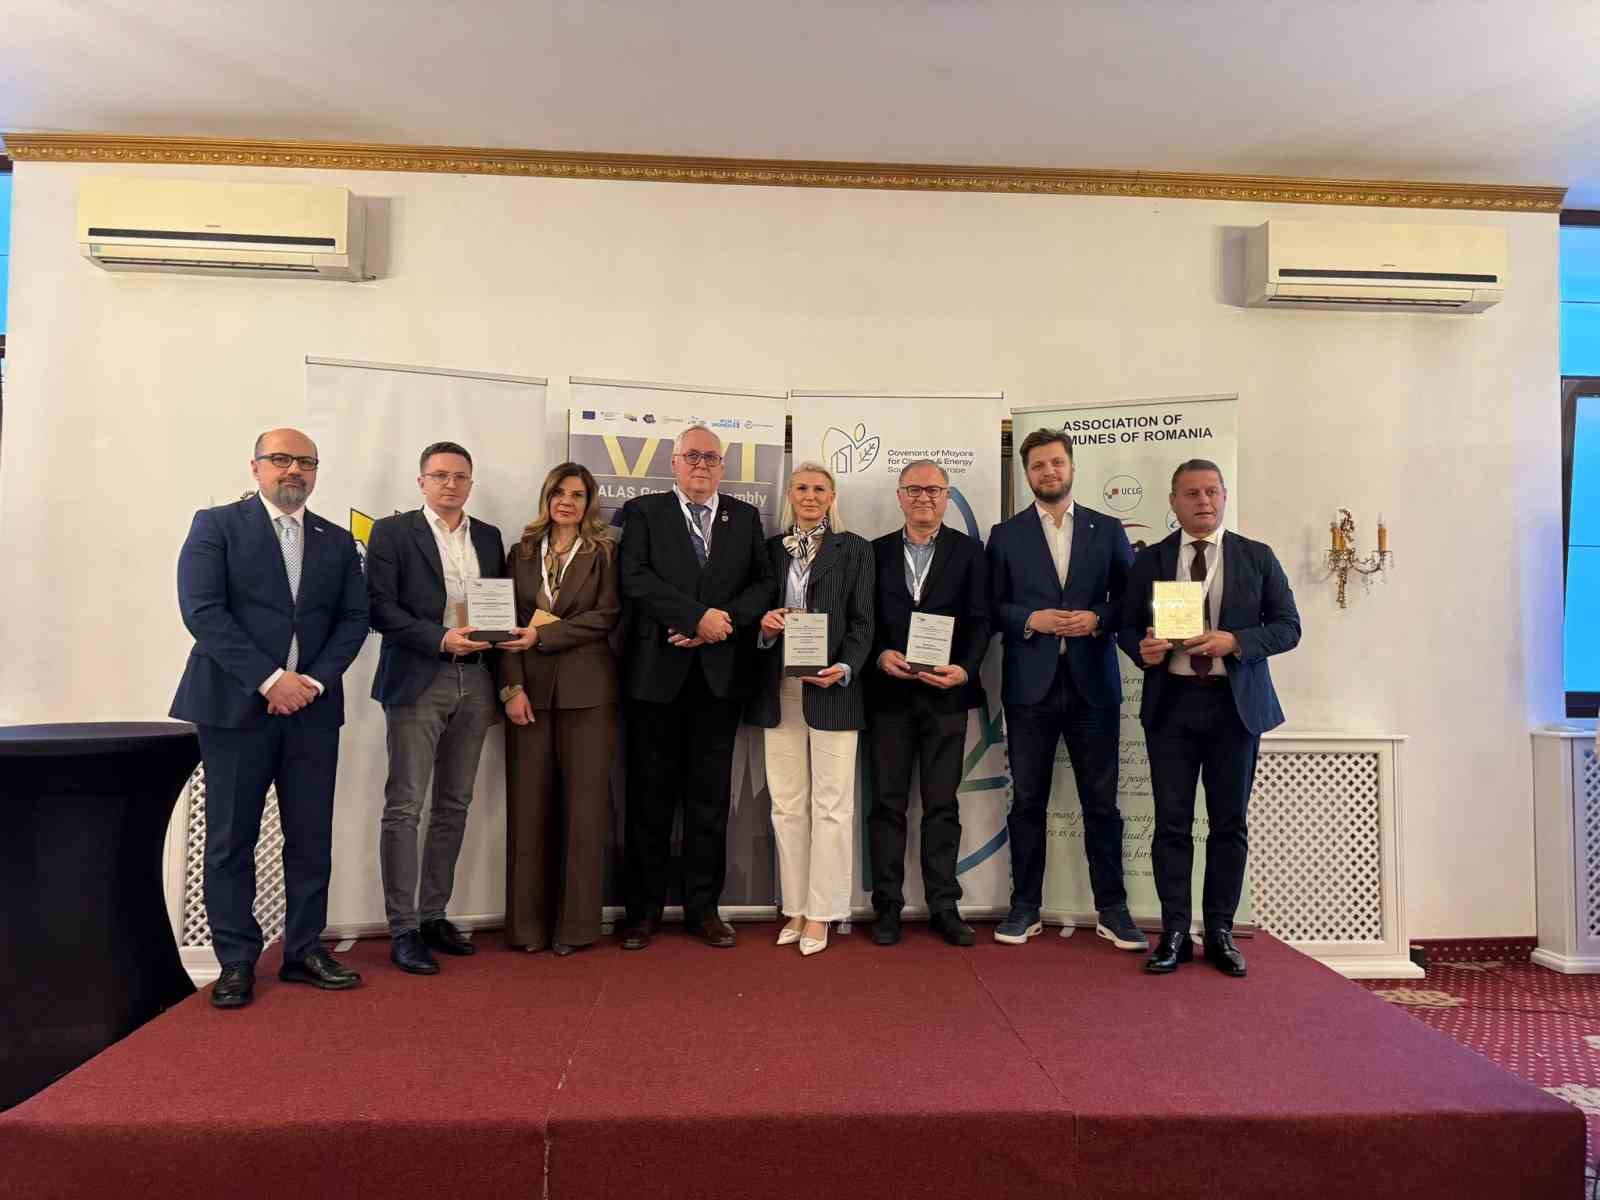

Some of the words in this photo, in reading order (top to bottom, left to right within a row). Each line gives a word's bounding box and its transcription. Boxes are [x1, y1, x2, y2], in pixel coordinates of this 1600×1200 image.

[1063, 415, 1159, 432] ASSOCIATION
[1163, 414, 1184, 426] OF
[1069, 433, 1117, 446] MUNES
[1120, 431, 1140, 443] OF
[1144, 427, 1214, 442] ROMANIA
[887, 449, 930, 457] Covenant
[930, 449, 940, 457] of
[941, 449, 974, 458] Mayors
[944, 458, 974, 467] Energy
[597, 484, 636, 499] ALAS
[1121, 487, 1143, 496] UCLG
